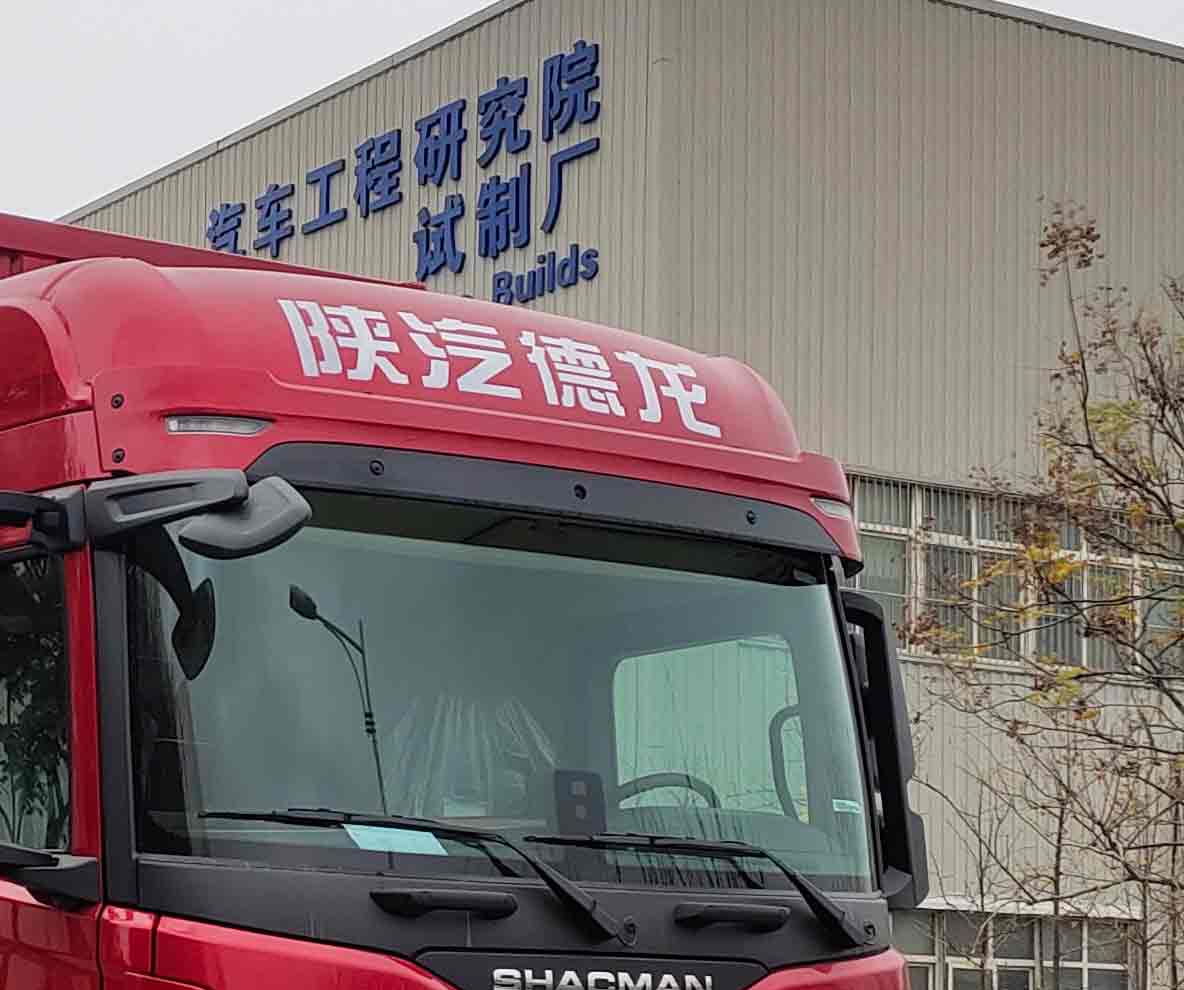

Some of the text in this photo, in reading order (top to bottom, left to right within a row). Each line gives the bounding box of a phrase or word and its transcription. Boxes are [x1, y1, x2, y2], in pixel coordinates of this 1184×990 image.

[207, 39, 601, 257] 汽车工程研究院
[414, 136, 601, 282] 试制厂
[492, 243, 599, 305] Builds
[277, 298, 722, 438] 陕汽德龙
